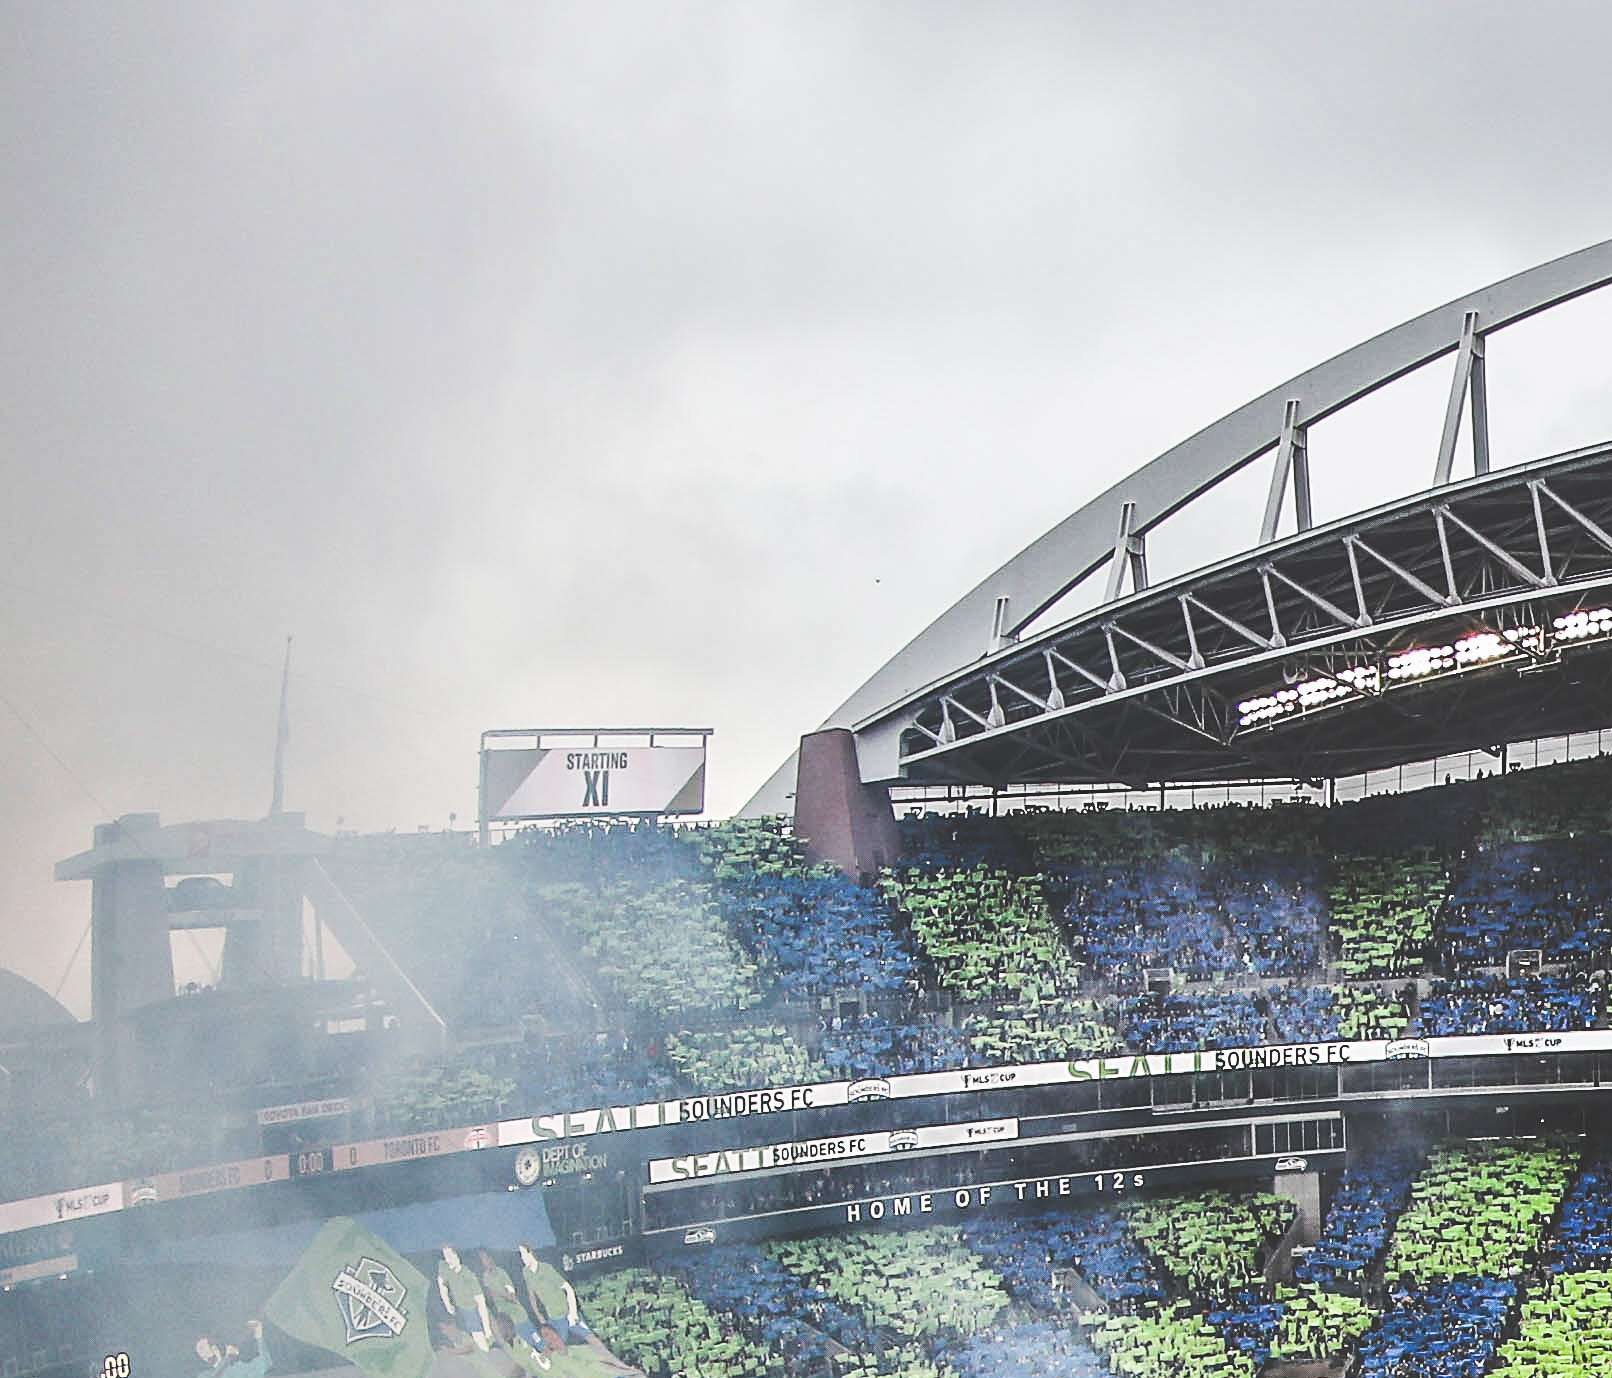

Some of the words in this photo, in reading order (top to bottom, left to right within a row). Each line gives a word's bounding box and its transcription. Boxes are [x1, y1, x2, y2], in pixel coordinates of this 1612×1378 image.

[566, 752, 628, 770] STARTING
[582, 770, 608, 807] XI
[1516, 1039, 1534, 1048] MLS
[1544, 1038, 1562, 1047] CUP
[1215, 1046, 1320, 1070] SOUNDERS
[1328, 1044, 1350, 1063] FC
[1000, 1073, 1016, 1083] CUP
[680, 1090, 784, 1122] SOUNDERS
[791, 1088, 814, 1109] FC
[384, 1139, 425, 1159] TORONTO
[426, 1136, 440, 1152] FC
[543, 1146, 570, 1163] DEPT
[572, 1143, 588, 1159] OF
[772, 1138, 846, 1163] SOUNDERS
[849, 1138, 866, 1153] FC
[847, 1194, 933, 1223] HOME
[955, 1186, 992, 1208] OF
[1014, 1177, 1071, 1201] THE
[1095, 1172, 1144, 1192] 12s
[576, 1245, 624, 1264] STARBUCKS
